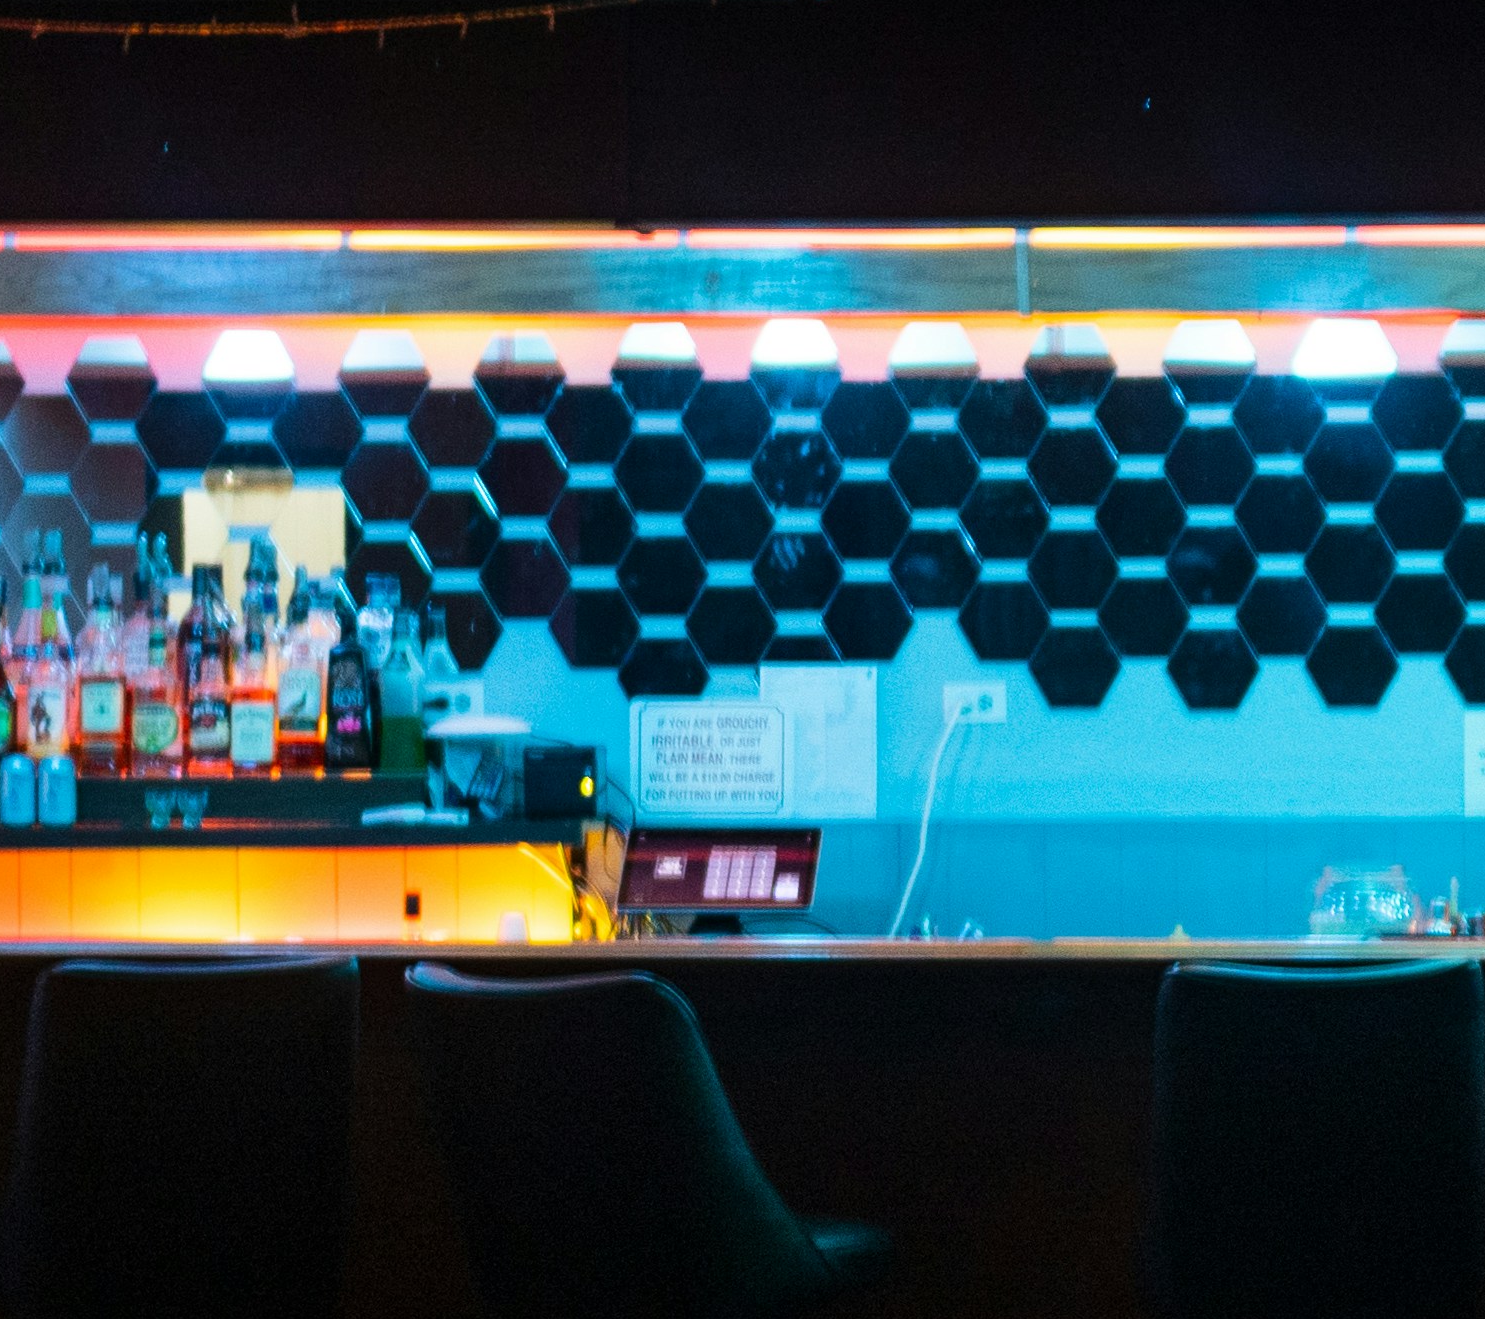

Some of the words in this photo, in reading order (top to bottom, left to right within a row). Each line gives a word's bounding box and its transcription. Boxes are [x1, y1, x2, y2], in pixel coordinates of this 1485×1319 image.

[668, 717, 690, 729] YOU
[693, 717, 713, 728] ARE
[737, 736, 761, 748] JUST
[656, 752, 688, 764] PLAIN
[729, 755, 762, 765] THERE
[648, 772, 672, 783] WILL
[691, 772, 699, 783] A
[733, 772, 774, 783] CHARGE
[645, 789, 667, 801] FOR
[668, 789, 711, 801] PUTTING
[714, 789, 728, 801] UP
[730, 789, 755, 801] WITH
